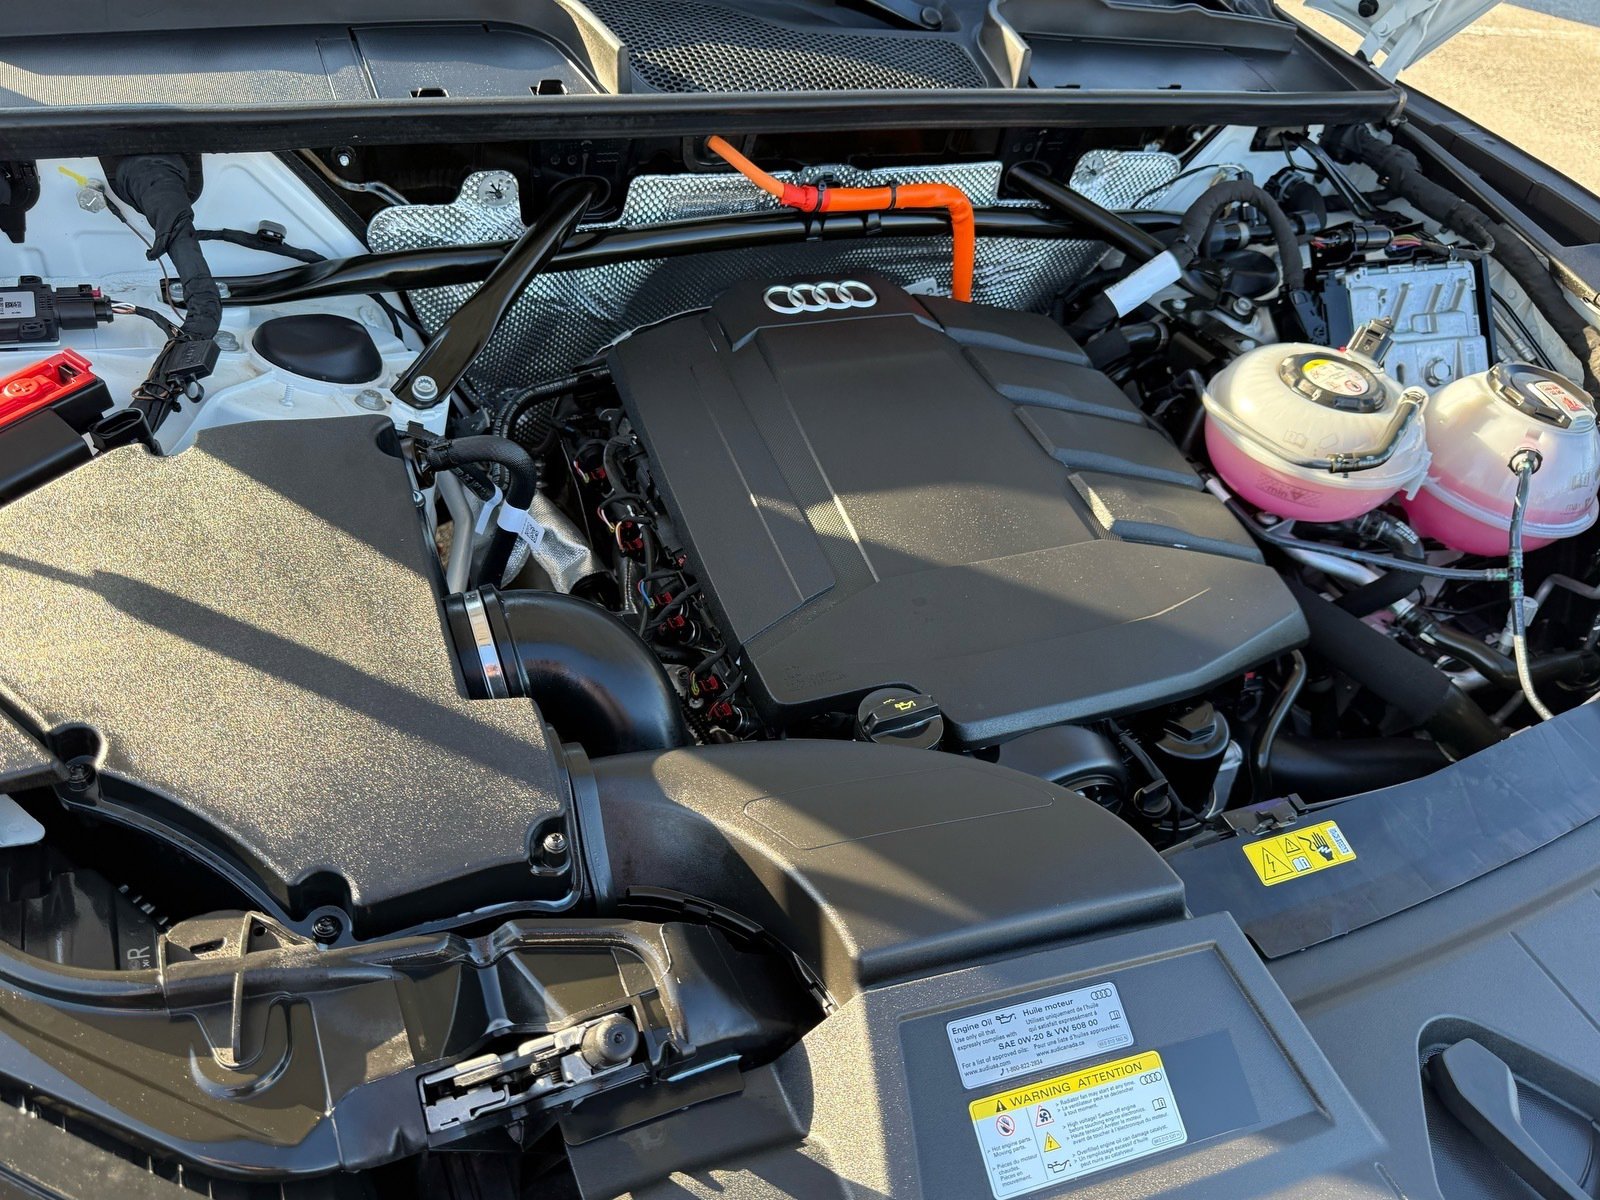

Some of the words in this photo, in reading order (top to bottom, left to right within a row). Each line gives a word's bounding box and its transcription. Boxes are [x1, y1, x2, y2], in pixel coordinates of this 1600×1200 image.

[127, 946, 150, 960] R
[1023, 1006, 1043, 1017] Huile
[1045, 999, 1074, 1011] moteur
[1026, 1016, 1045, 1025] Utilisez
[1045, 1009, 1076, 1021] uniquement
[952, 1022, 980, 1036] Engine
[1038, 1021, 1058, 1030] satisfait
[999, 1040, 1016, 1050] SAE
[1018, 1033, 1044, 1045] 0W-20
[1055, 1026, 1070, 1035] VW
[1072, 1022, 1087, 1031] 508
[957, 1041, 981, 1052] expressly
[982, 1035, 1006, 1045] complies
[1036, 1041, 1085, 1057] www.audicanada.ca
[992, 1050, 1017, 1062] approved
[964, 1060, 1011, 1076] www.audiusa.com
[1010, 1082, 1071, 1107] WARNING
[1077, 1062, 1143, 1088] ATTENTION
[1105, 1115, 1121, 1123] engine
[1002, 1141, 1018, 1150] engine
[1100, 1142, 1116, 1150] engine
[994, 1149, 1012, 1158] Moving
